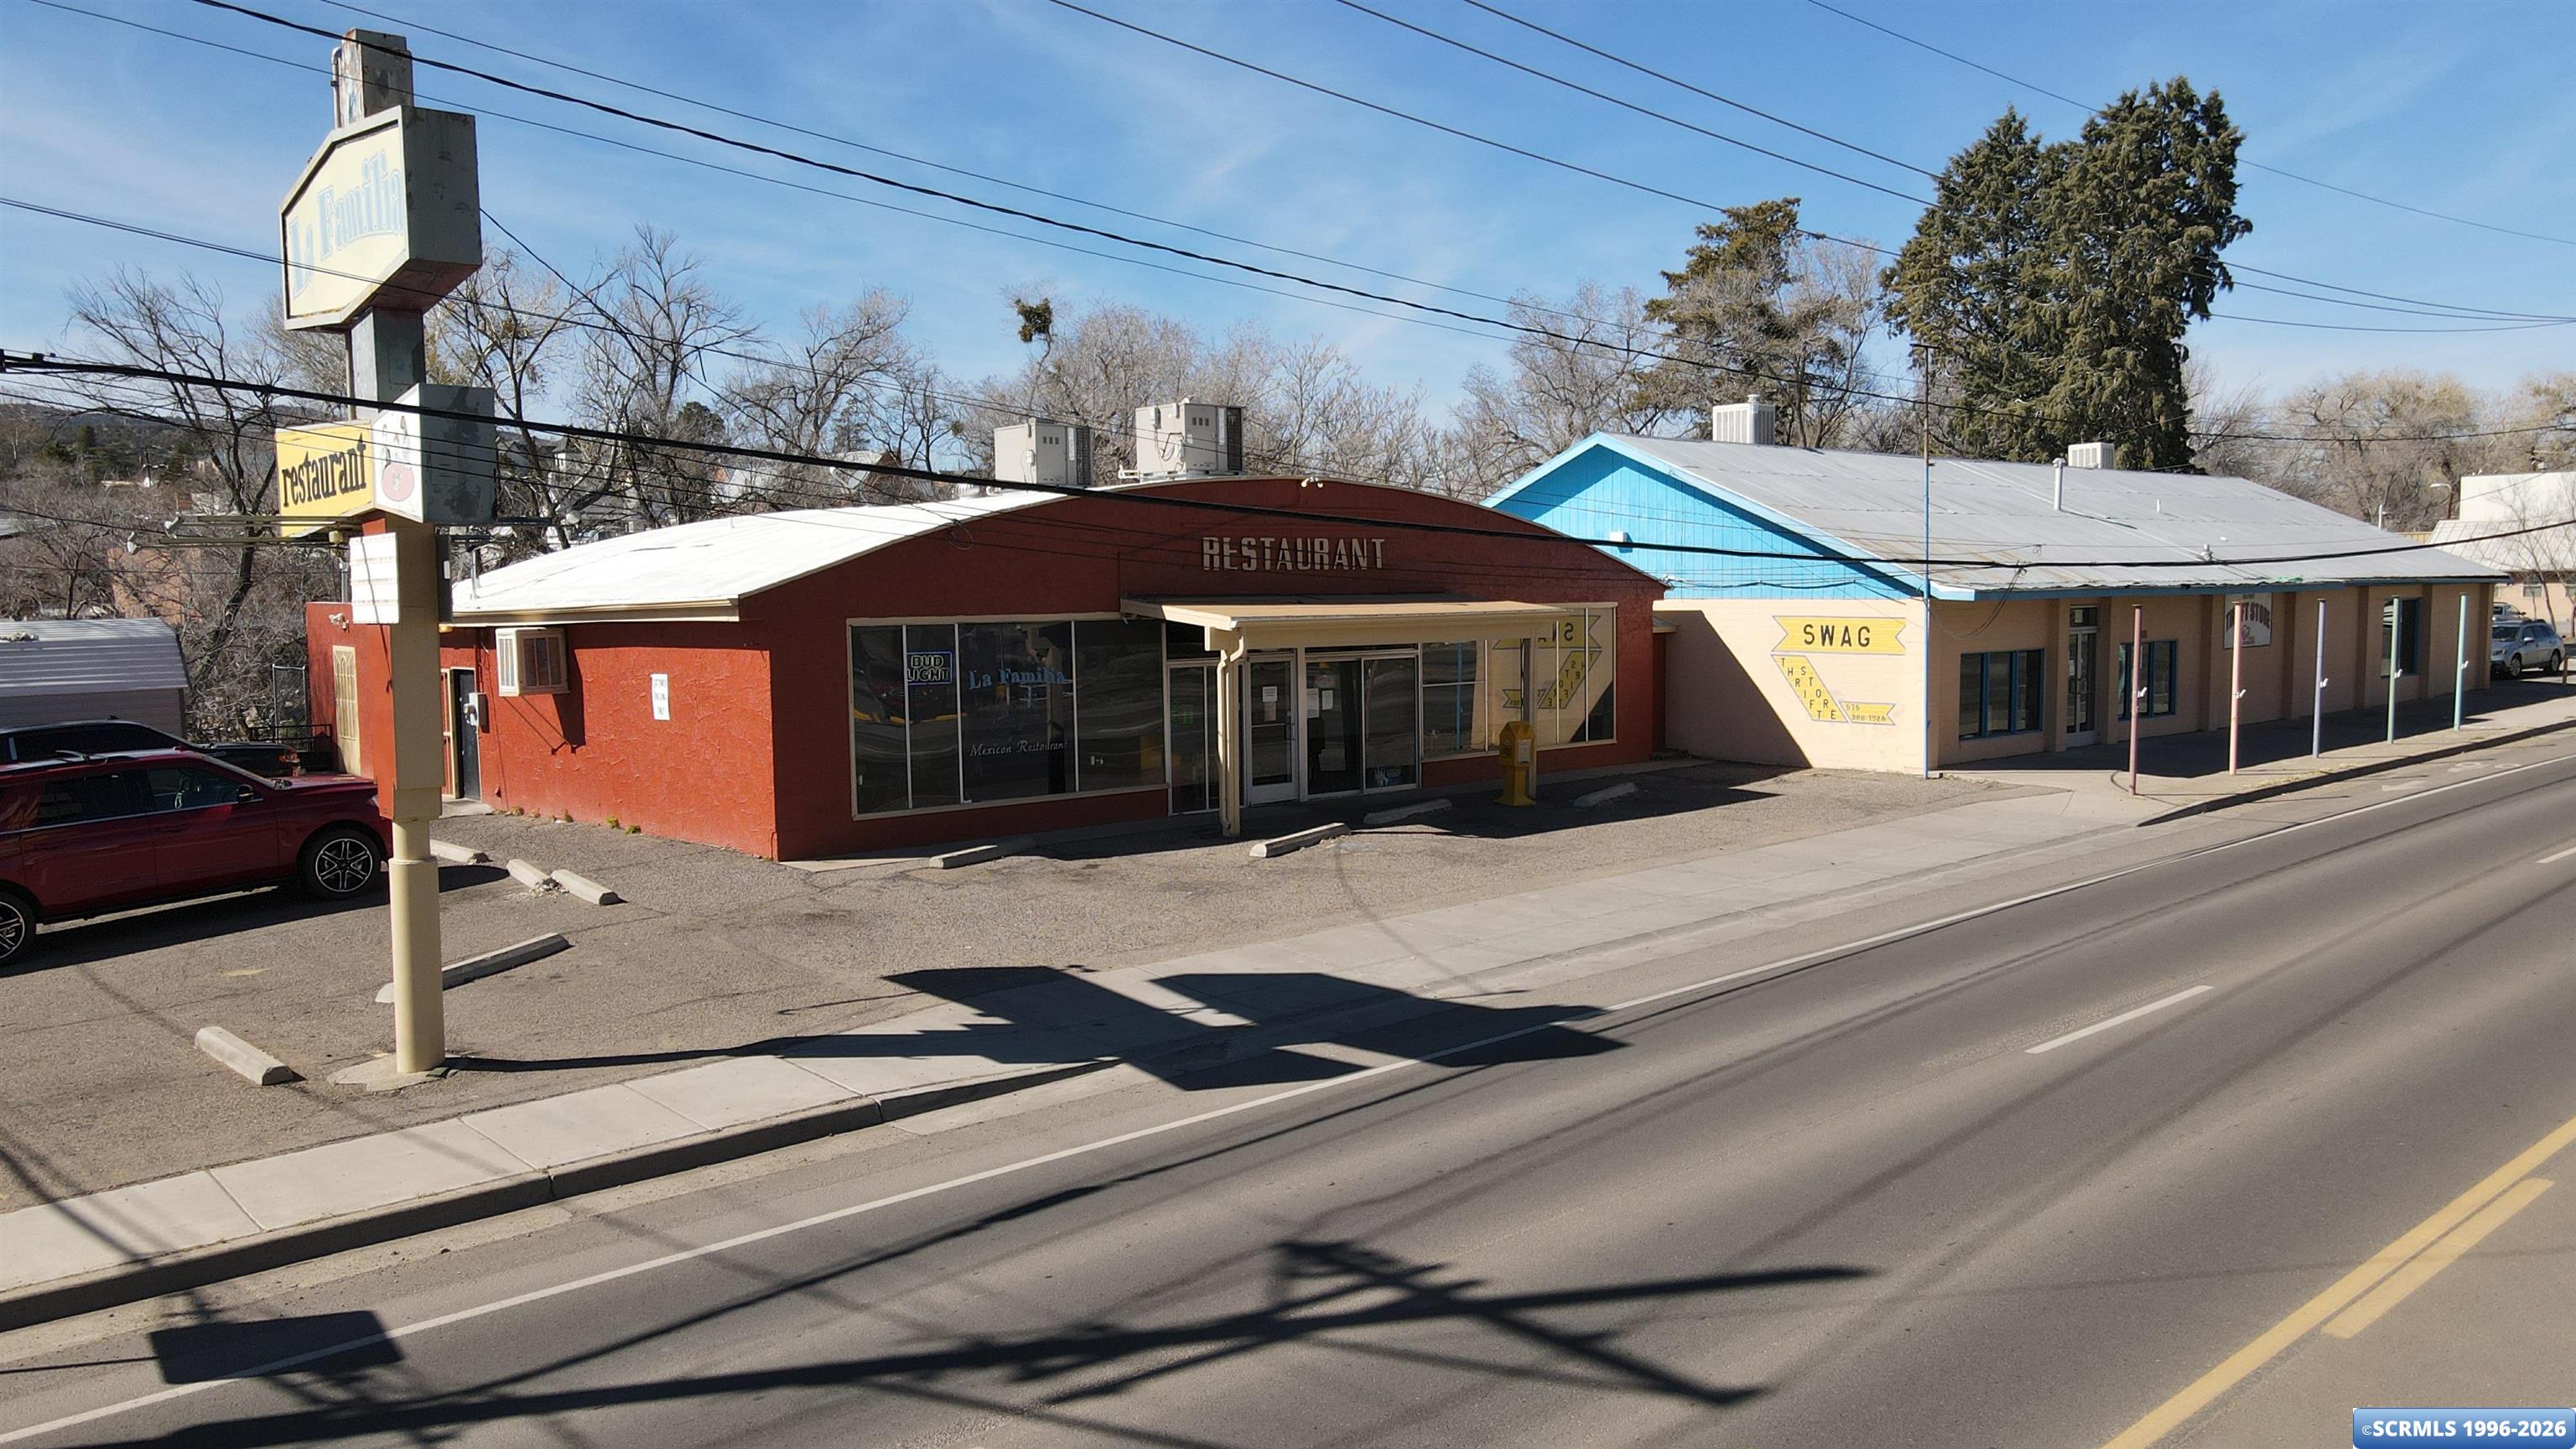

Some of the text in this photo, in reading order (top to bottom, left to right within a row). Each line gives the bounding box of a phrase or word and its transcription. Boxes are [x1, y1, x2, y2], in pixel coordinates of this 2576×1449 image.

[316, 148, 405, 261] Familia
[282, 433, 366, 507] restaurant
[1202, 537, 1384, 571] RESTAURANT
[1803, 624, 1871, 647] SWAG
[911, 655, 944, 668] BUD
[906, 667, 949, 681] LIGHT
[969, 666, 1067, 690] La Familia
[969, 740, 1069, 757] Mexican Restaurant
